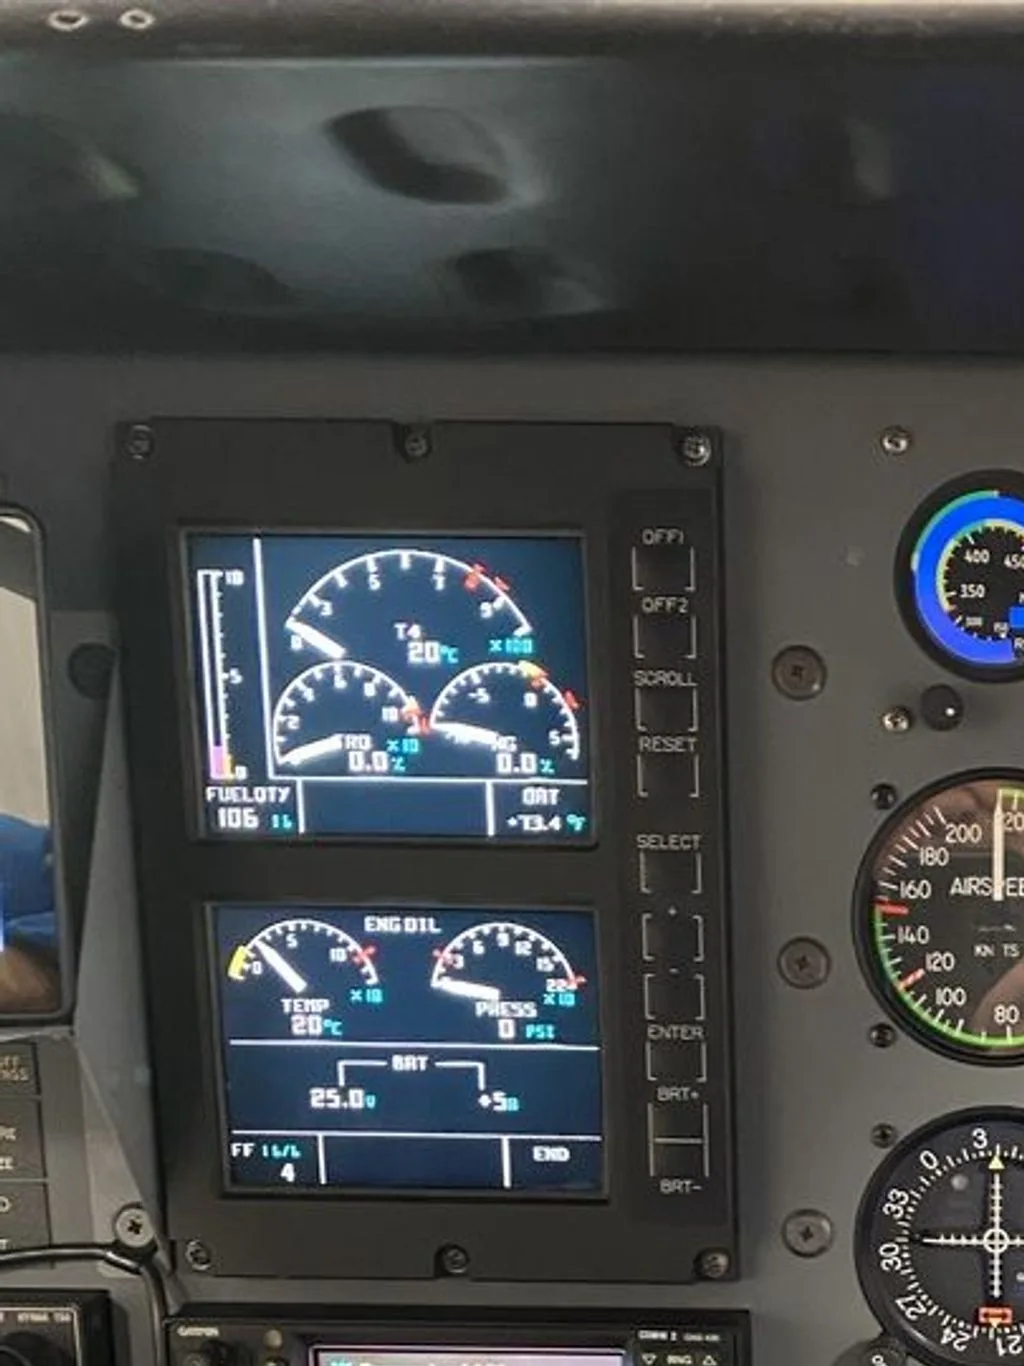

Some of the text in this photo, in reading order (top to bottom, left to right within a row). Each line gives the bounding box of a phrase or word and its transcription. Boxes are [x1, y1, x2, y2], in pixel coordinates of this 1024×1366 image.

[964, 550, 990, 563] 400
[960, 584, 985, 599] 350
[642, 597, 688, 613] OFF2
[394, 622, 422, 640] T4
[634, 670, 698, 686] SCROLL
[639, 736, 697, 752] RESET
[217, 807, 259, 829] 106
[636, 833, 701, 850] SELECT
[945, 824, 982, 843] 200
[919, 847, 949, 866] 180
[901, 880, 931, 899] 160
[364, 916, 442, 934] ENG OIL
[897, 926, 930, 944] 140
[925, 953, 955, 970] 120
[935, 988, 966, 1006] 100
[281, 999, 330, 1014] TEMP
[994, 1006, 1020, 1023] 80
[647, 1024, 704, 1041] ENTER
[231, 1142, 254, 1157] FF
[882, 1188, 909, 1219] 33
